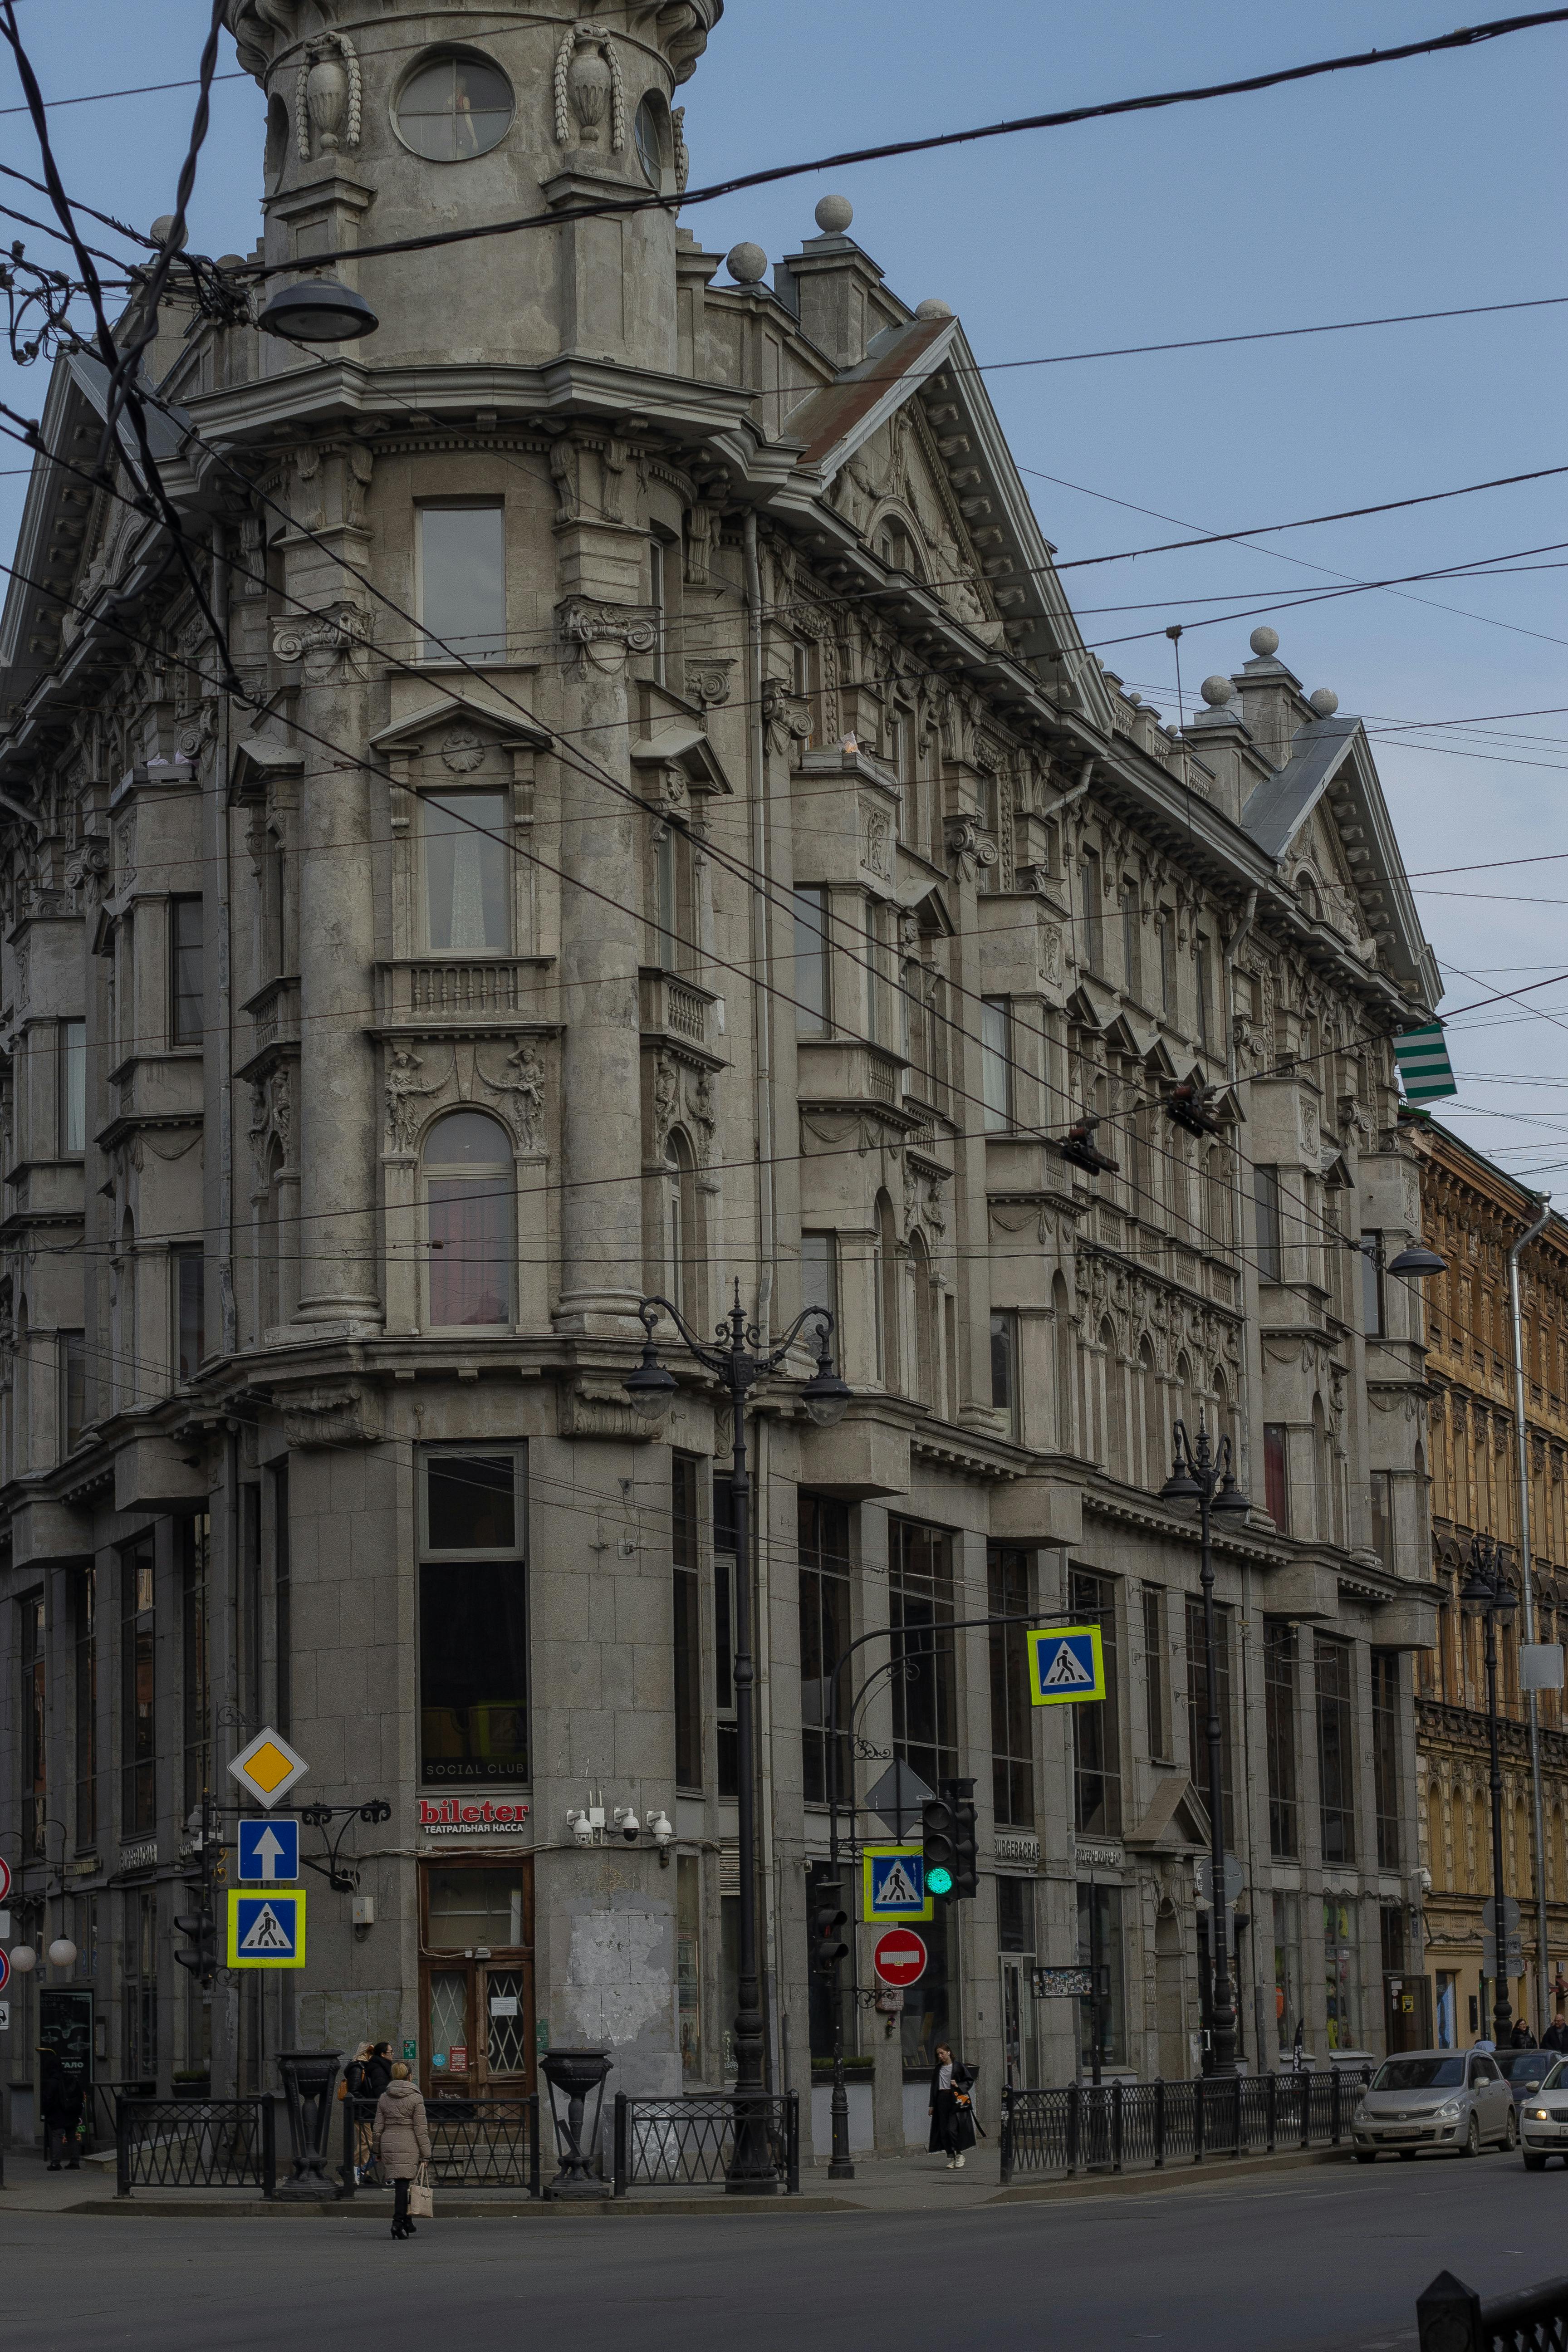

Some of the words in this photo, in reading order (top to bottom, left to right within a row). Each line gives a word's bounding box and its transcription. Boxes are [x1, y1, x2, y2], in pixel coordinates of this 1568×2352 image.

[426, 1764, 482, 1775] SOCIAL
[488, 1764, 524, 1774] CLUB
[419, 1799, 529, 1824] bileter
[424, 1824, 491, 1834] ТЕАТРАЛЬНАЯ
[493, 1823, 524, 1832] КАССА
